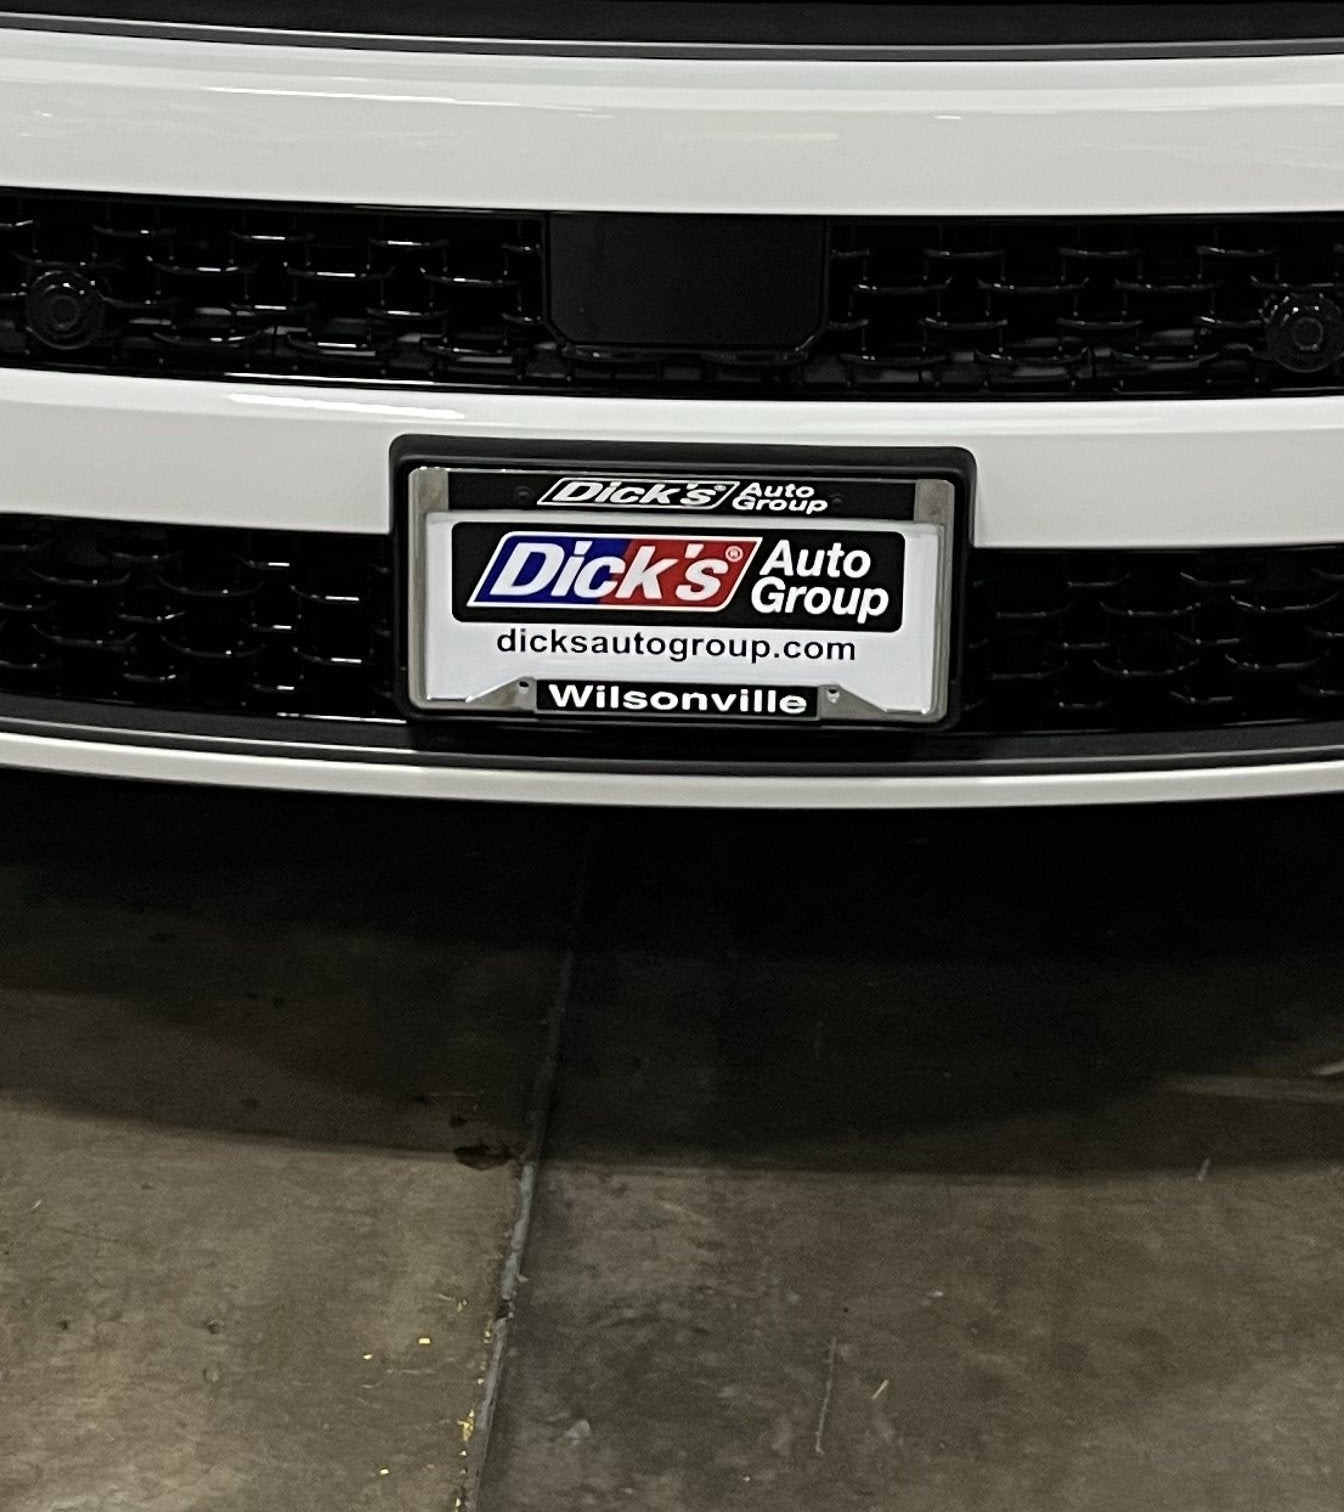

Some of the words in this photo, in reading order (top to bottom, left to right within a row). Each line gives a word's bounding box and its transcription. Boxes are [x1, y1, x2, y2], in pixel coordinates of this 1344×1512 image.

[552, 481, 718, 506] Dick's
[732, 496, 829, 515] Group
[740, 482, 815, 499] Auto
[489, 540, 730, 602] Dick's
[759, 539, 872, 579] Auto
[751, 576, 890, 625] Group
[496, 628, 856, 664] dicksautogroup.com
[548, 683, 808, 715] Wilsonville
